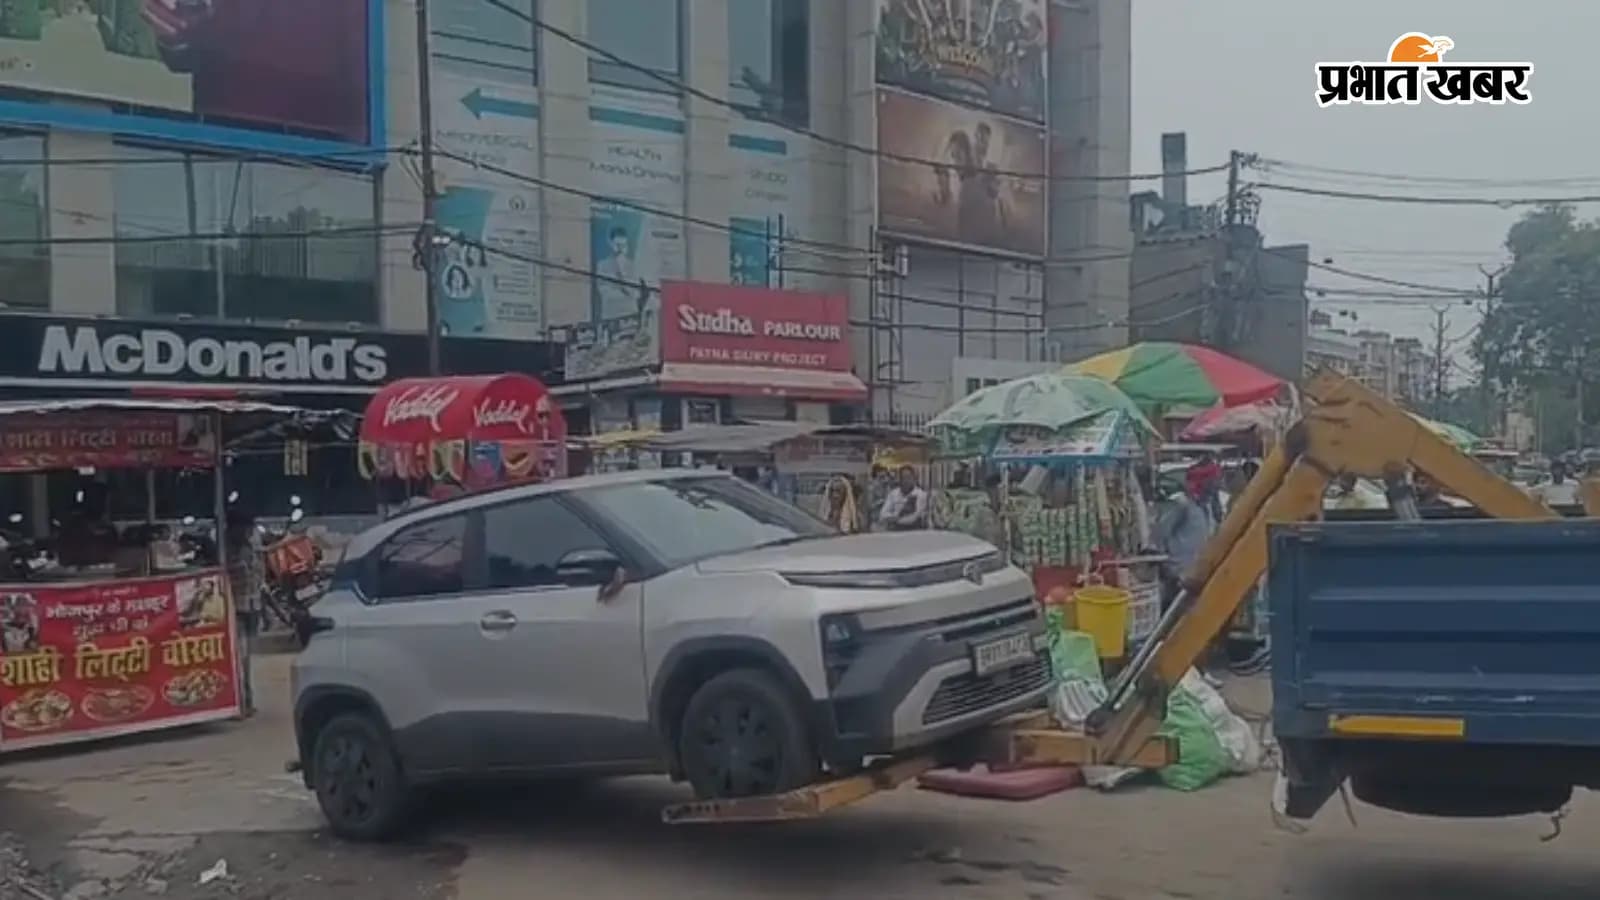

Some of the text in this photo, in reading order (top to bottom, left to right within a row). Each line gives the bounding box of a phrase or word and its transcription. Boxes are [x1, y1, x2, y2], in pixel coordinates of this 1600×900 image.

[678, 304, 841, 341] Sudha PARLOUR
[38, 325, 388, 382] McDonald's
[689, 347, 730, 360] PATNA
[772, 351, 828, 366] PROJECT
[0, 644, 64, 687] शाही
